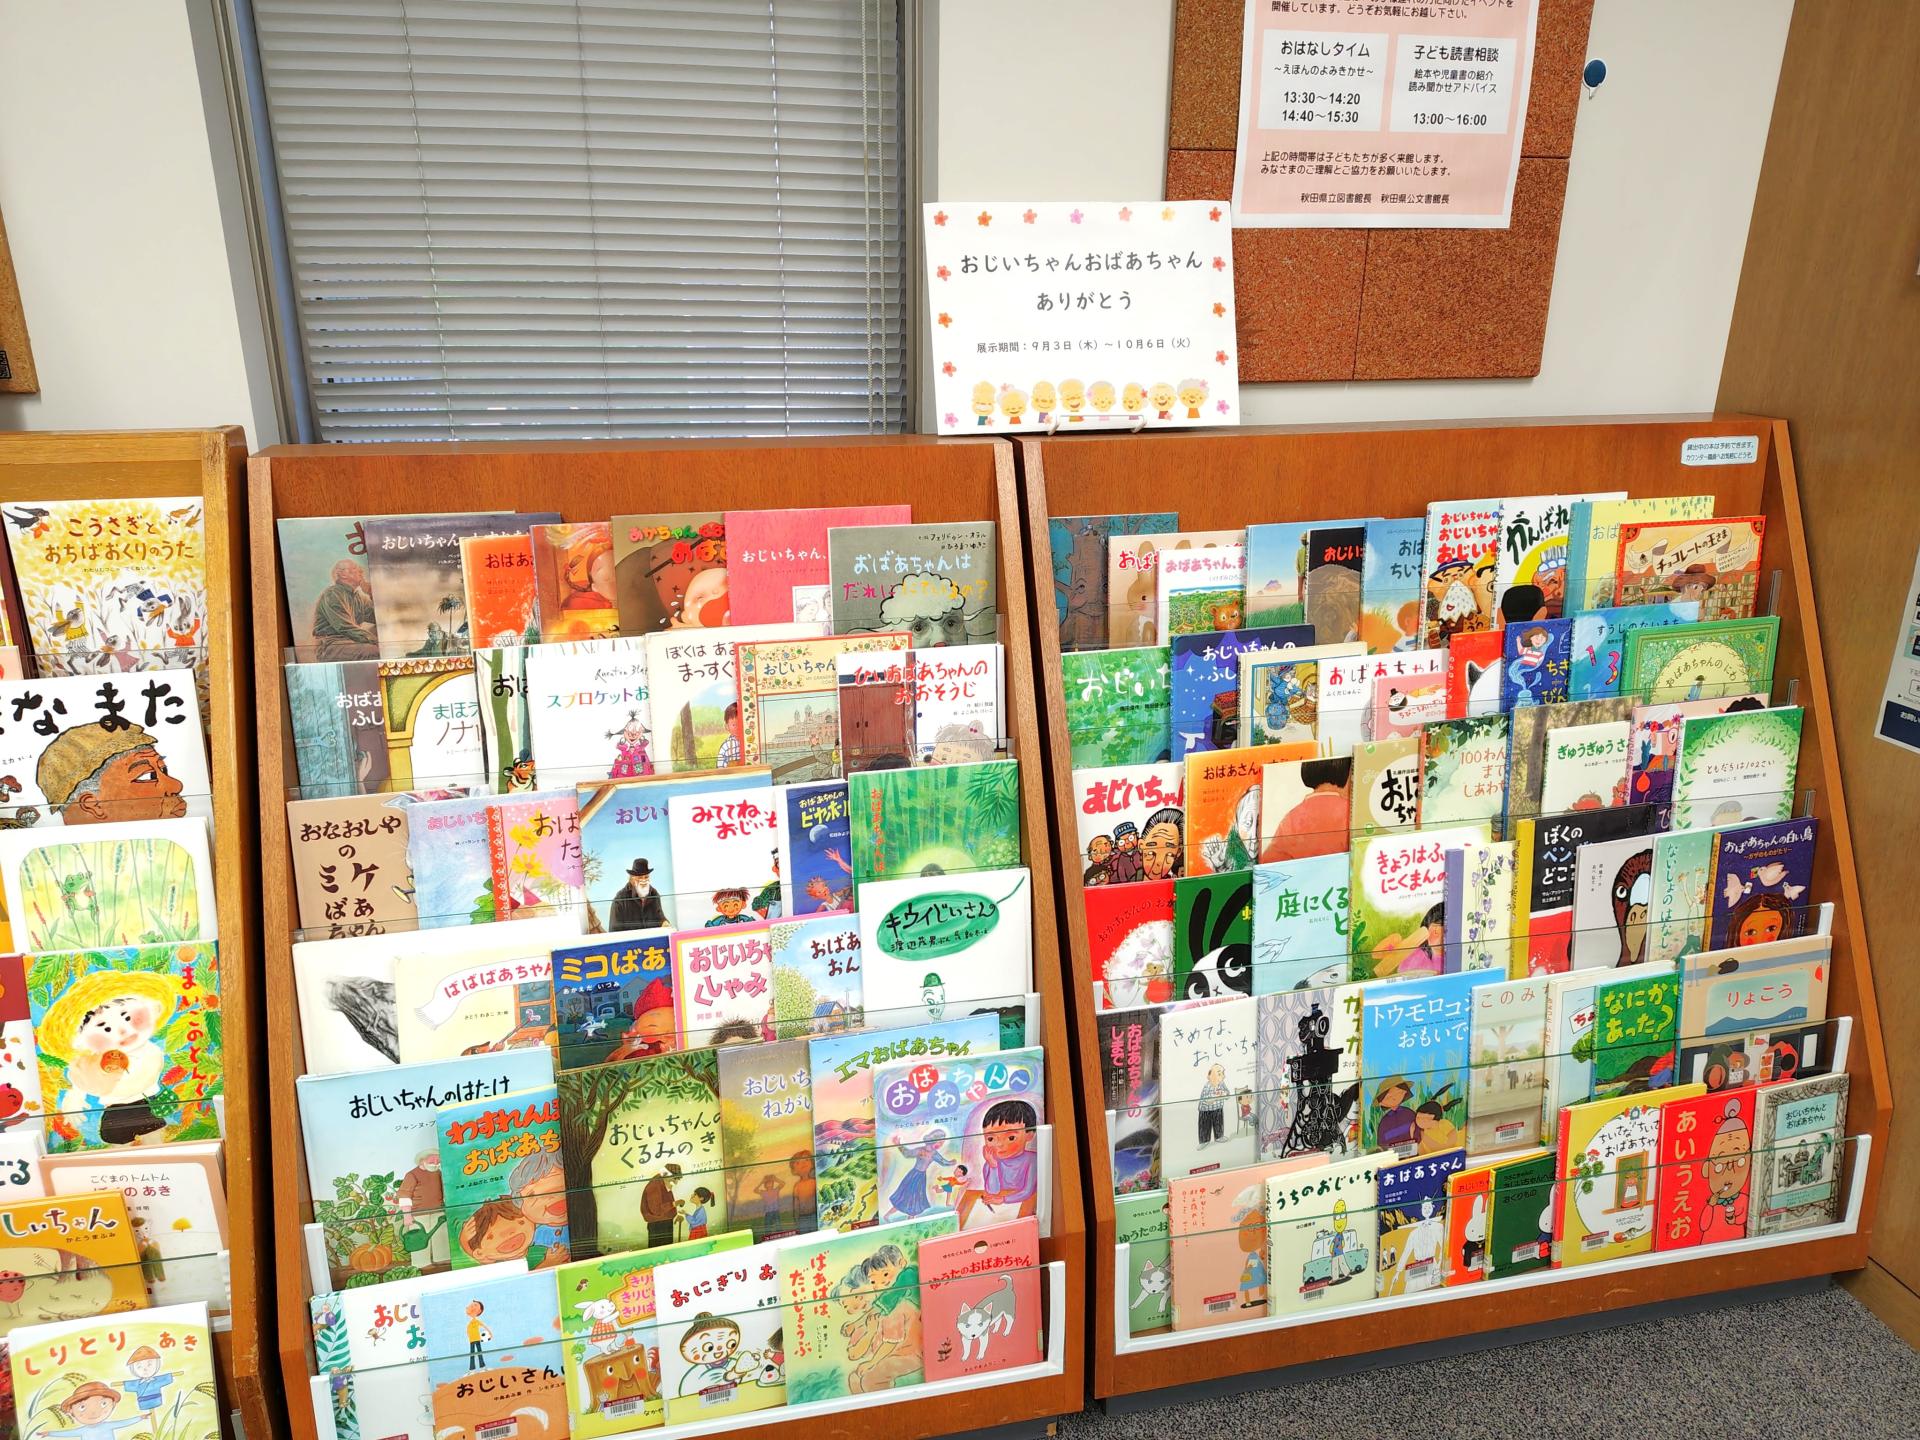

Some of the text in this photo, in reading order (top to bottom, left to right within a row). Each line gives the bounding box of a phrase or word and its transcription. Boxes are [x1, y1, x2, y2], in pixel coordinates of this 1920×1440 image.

[1280, 40, 1371, 59] おはなしタイム
[1413, 45, 1499, 62] 子ども読書相談
[1414, 68, 1494, 81] 絵本や児童書の紹介
[1283, 91, 1361, 106] 13:30～14:20
[1408, 80, 1497, 94] 読み聞かせアドバイス
[1282, 110, 1359, 124] 14:40～15:30
[1413, 112, 1487, 126] 13:00～16:00
[1301, 192, 1449, 206] 秋田県立図書館長 秋田県公文書館長
[961, 251, 1203, 274] おじいちゃんおばあちゃん
[1037, 290, 1133, 311] ありがとう
[69, 515, 159, 537] こうさぎと
[45, 540, 195, 564] おちばおくりのうた
[742, 547, 827, 563] おじいちゃん、
[854, 550, 971, 574] おばあちゃんは
[1324, 543, 1364, 561] おじい
[1656, 529, 1729, 574] チョコレートの王さま
[854, 660, 988, 685] ひいおばあちゃんの
[895, 681, 977, 705] おおそうじ
[0, 679, 186, 736] なまた
[799, 791, 845, 809] おばあちゃんの
[300, 816, 402, 842] おなおしや
[1544, 825, 1583, 845] ぼくの
[1724, 825, 1814, 854] おばあちゃんの白い鳥
[338, 844, 356, 860] の
[318, 862, 380, 894] ミケ
[325, 897, 375, 919] ばあ
[1276, 887, 1349, 922] 庭にくる
[885, 902, 997, 938] キウイじいさん
[693, 972, 768, 1007] くしゃみ
[1727, 984, 1793, 1008] りょこう
[1173, 1019, 1232, 1047] きめてよ、
[1398, 1021, 1469, 1048] おもいで
[1111, 1025, 1125, 1066] しまで
[834, 1036, 974, 1083] エマおばあちゃん
[1127, 1023, 1143, 1118] おばあちゃんの
[349, 1075, 511, 1119] おじいちゃんのはたけ
[892, 1064, 1028, 1108] おばあちゃんへ
[1785, 1104, 1827, 1120] おじいちゃんと
[1786, 1114, 1826, 1130] おばあちゃん
[620, 1131, 716, 1168] くるみのき
[90, 1173, 171, 1183] こぐまのトムトム
[1384, 1157, 1463, 1186] おばあちゃん
[1670, 1110, 1698, 1240] あいうえお
[670, 1268, 748, 1307] おにぎり
[788, 1268, 813, 1358] だいじょうぶ
[457, 1365, 566, 1398] おじいさん
